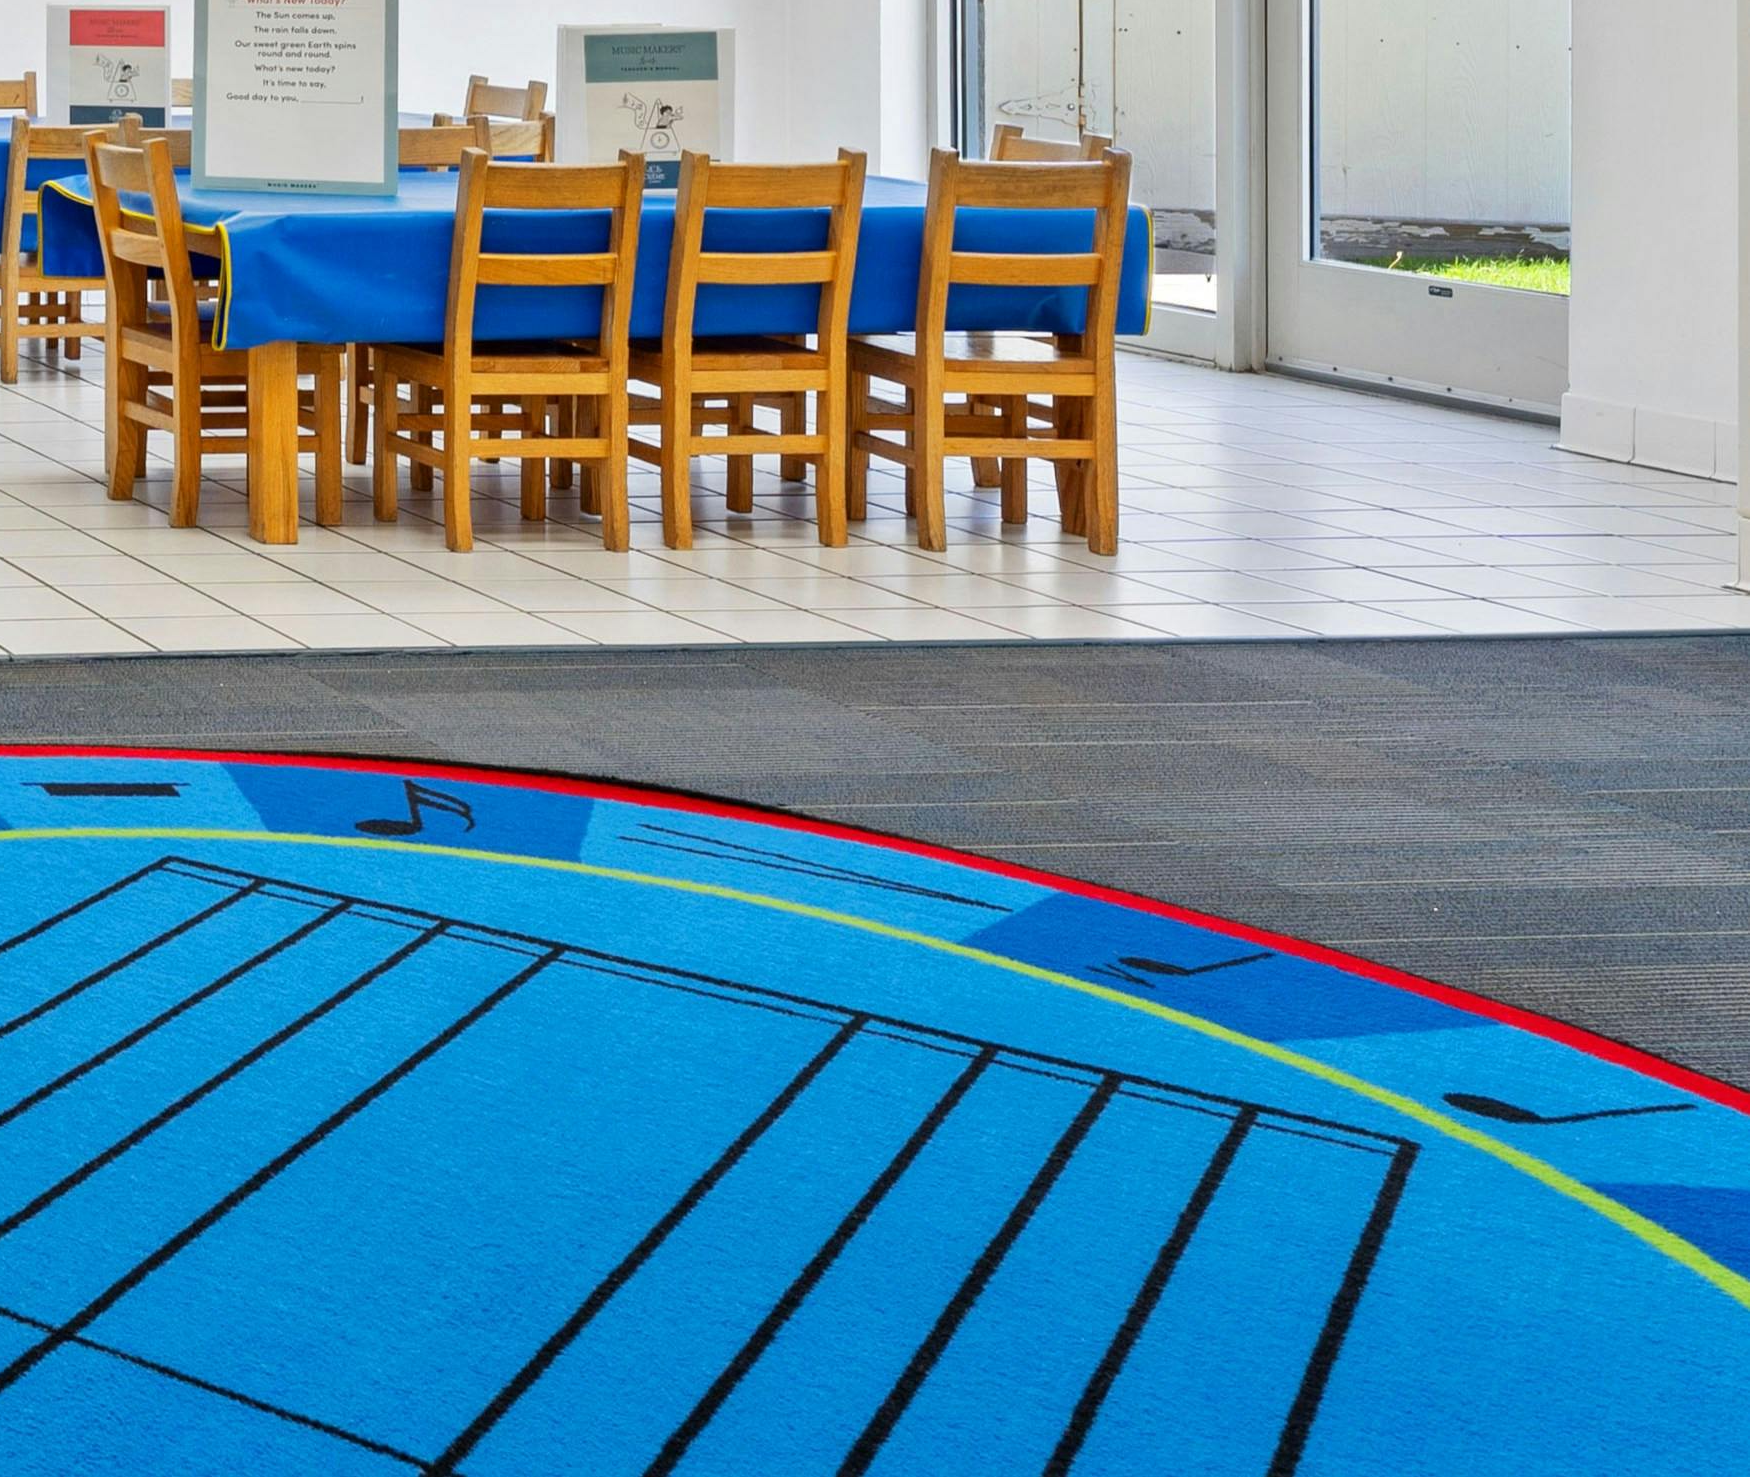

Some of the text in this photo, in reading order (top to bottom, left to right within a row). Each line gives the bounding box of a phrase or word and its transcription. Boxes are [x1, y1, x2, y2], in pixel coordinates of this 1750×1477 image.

[256, 11, 272, 19] The
[273, 11, 290, 19] Sun
[271, 26, 289, 34] rain
[291, 26, 309, 34] falls
[234, 40, 251, 48] Our
[280, 42, 306, 50] green
[308, 41, 332, 49] Earth
[334, 42, 356, 51] spins
[611, 45, 642, 55] MUSIC
[285, 50, 302, 58] and
[305, 65, 336, 75] today?
[277, 79, 297, 87] time
[226, 92, 250, 100] Good
[251, 92, 268, 103] day
[270, 93, 280, 101] to
